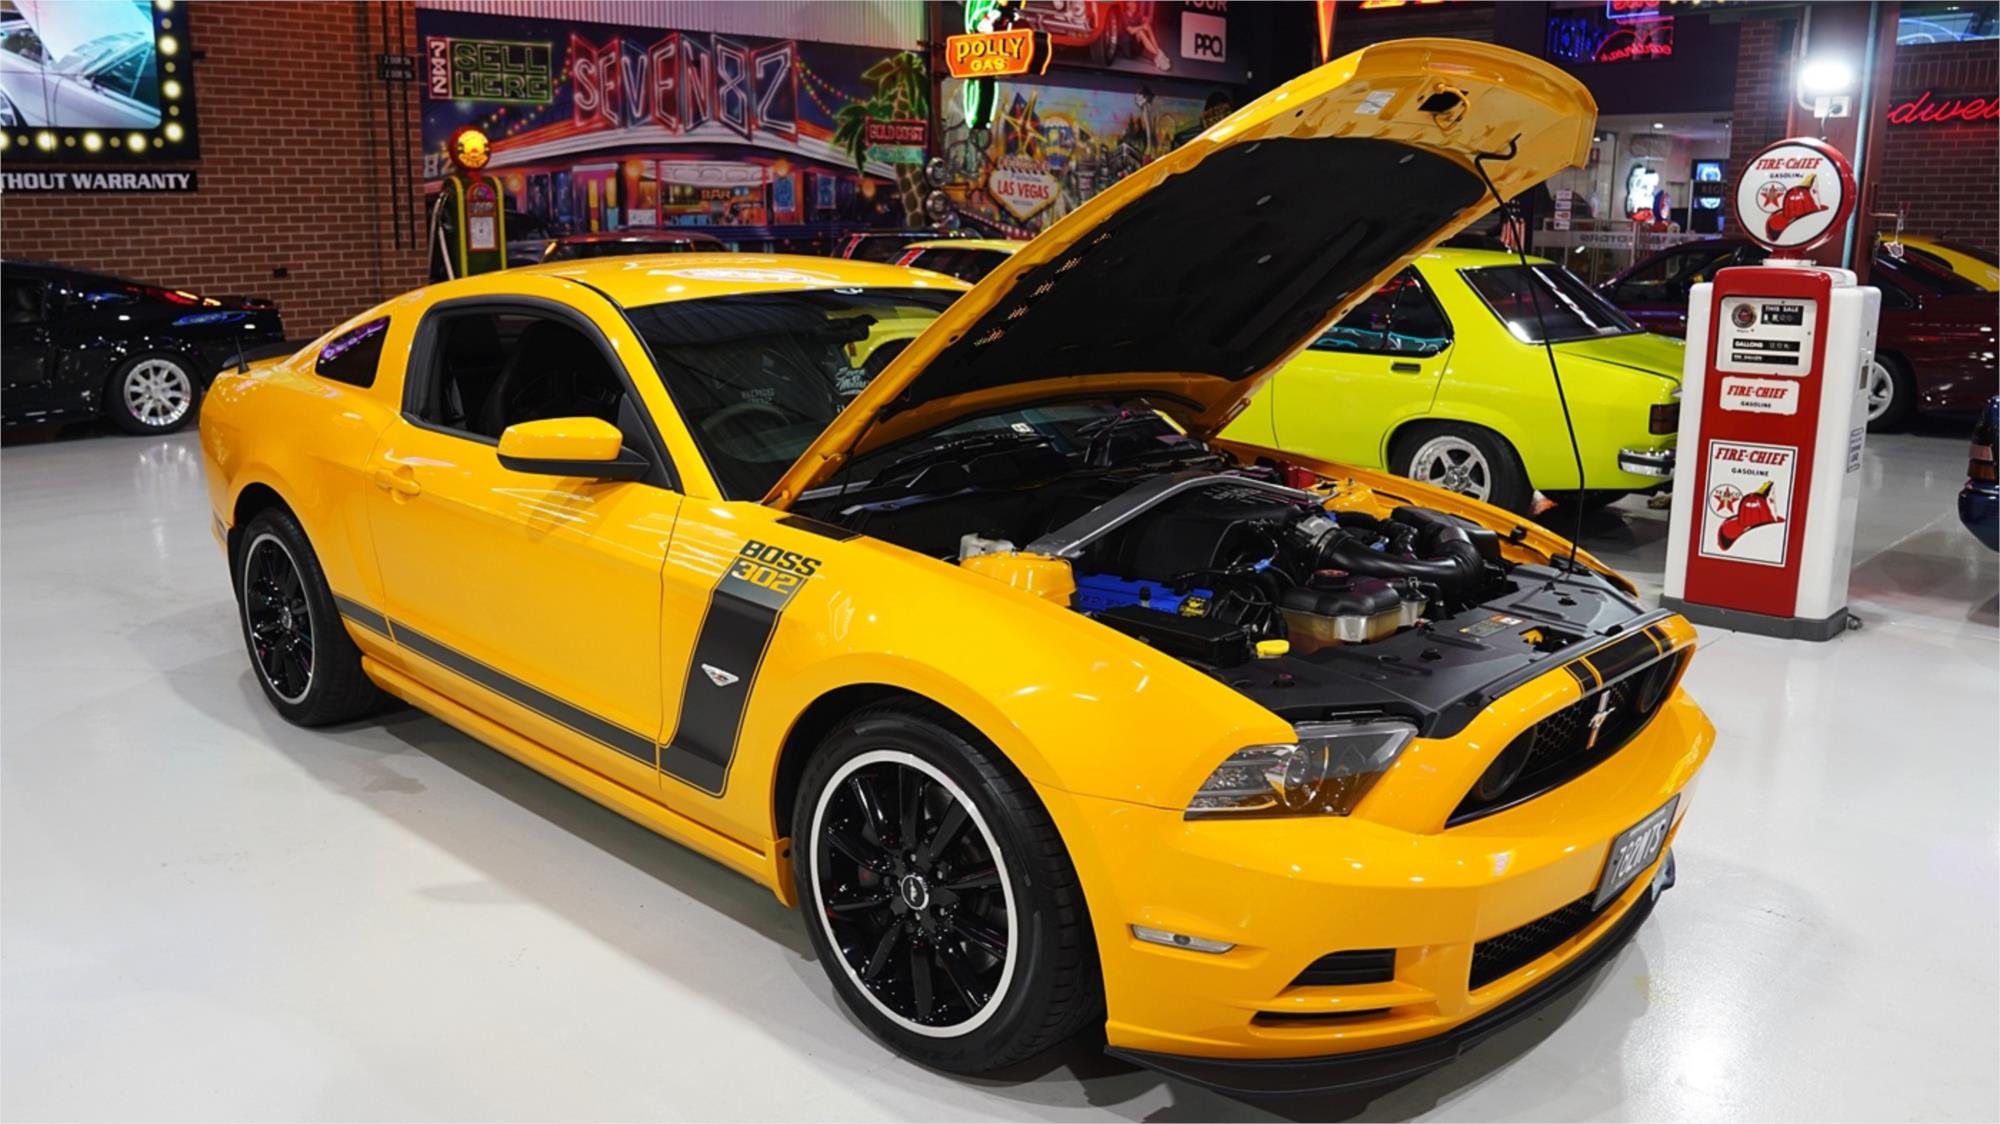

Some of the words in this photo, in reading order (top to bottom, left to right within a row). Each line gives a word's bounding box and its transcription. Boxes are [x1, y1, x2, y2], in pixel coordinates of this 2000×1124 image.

[955, 37, 1024, 63] POLLY
[1194, 33, 1223, 58] PPQ
[454, 44, 548, 73] SELL
[970, 58, 1005, 71] GAS
[455, 71, 549, 98] HERE
[1888, 91, 1999, 124] dwei
[1756, 158, 1823, 170] FIRE-CHIEF
[71, 173, 190, 189] WARRANTY
[998, 180, 1014, 196] LAS
[1017, 182, 1048, 199] VEGAS
[1727, 385, 1788, 399] FIRE-CHIEF
[1740, 401, 1772, 409] GASOLINE
[1715, 447, 1789, 466] FIRE-CHIEF
[1731, 467, 1769, 477] GASOLINE
[739, 539, 822, 576] BOSS
[731, 560, 800, 595] 302
